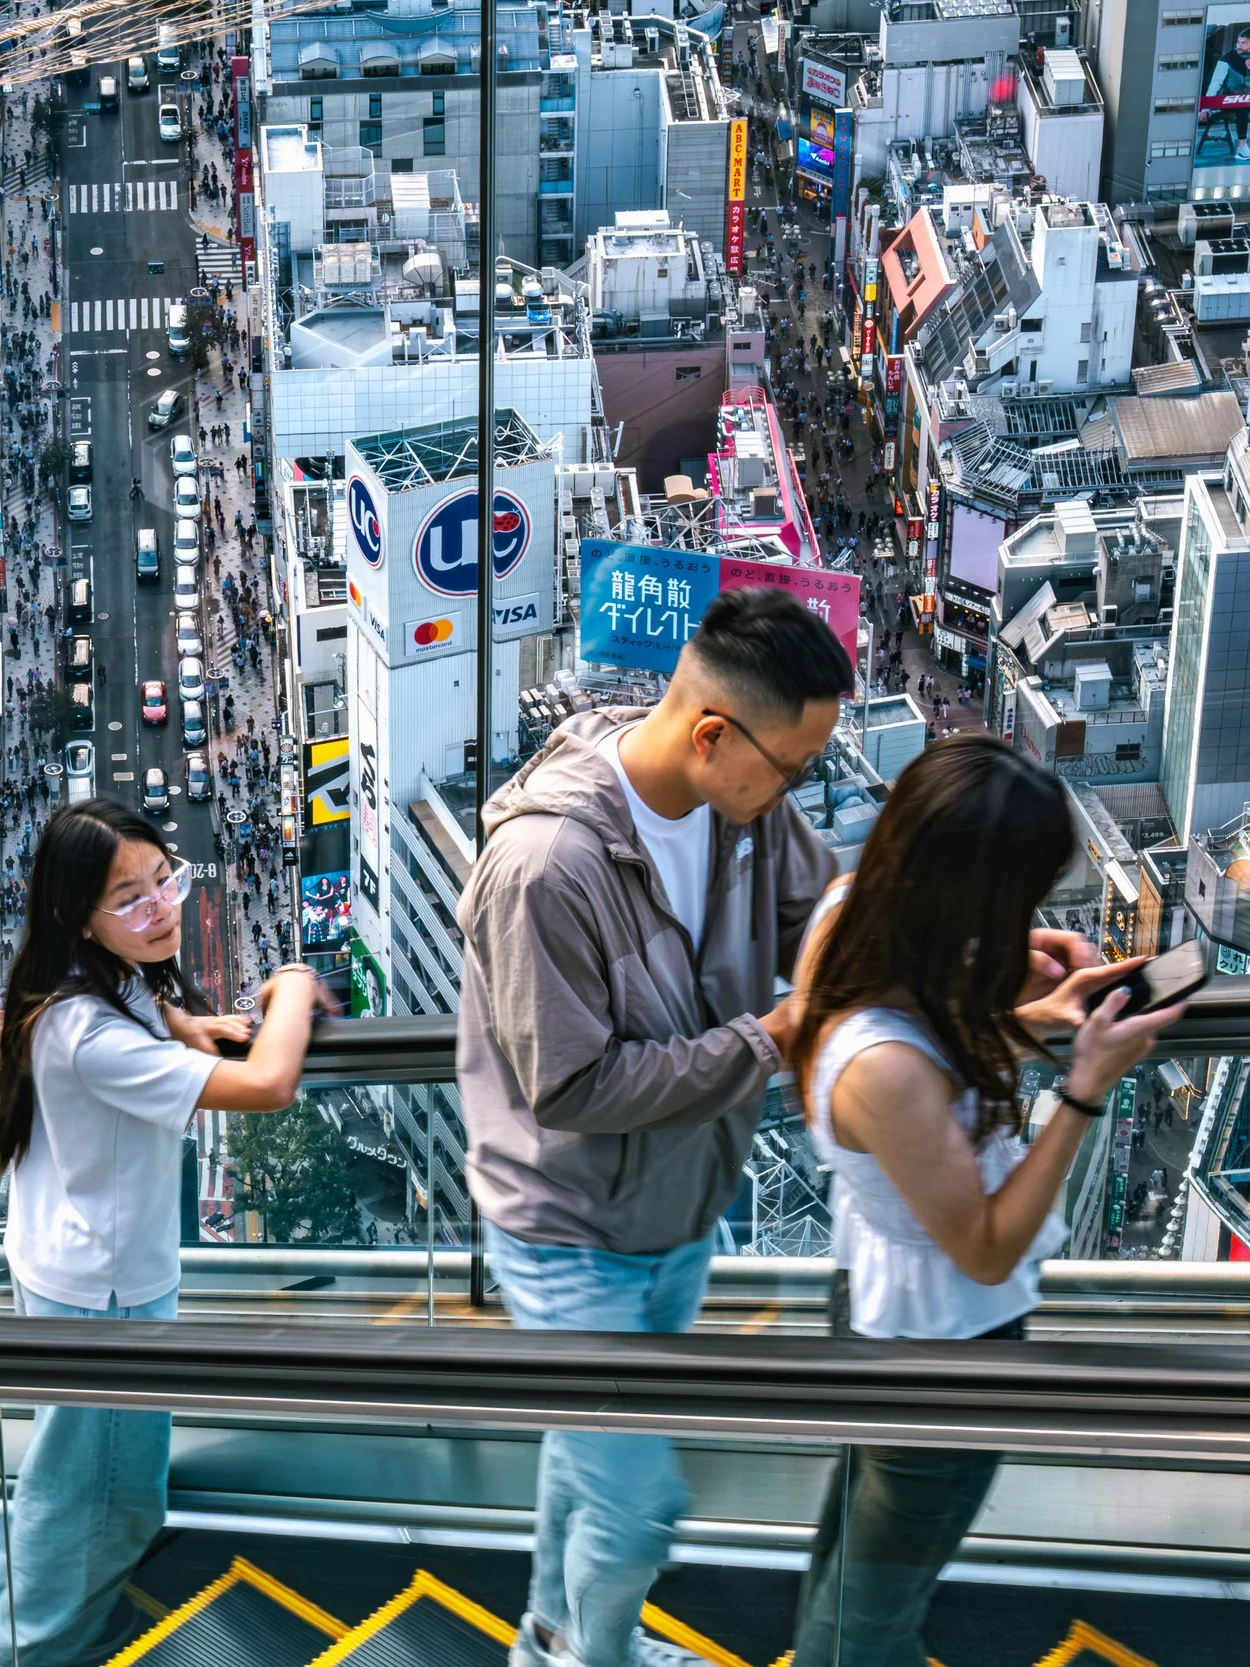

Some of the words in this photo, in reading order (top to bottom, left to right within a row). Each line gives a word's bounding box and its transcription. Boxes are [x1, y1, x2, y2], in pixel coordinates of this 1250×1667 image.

[611, 570, 691, 609] 龍角散
[492, 603, 537, 625] VISA
[599, 602, 702, 641] ダイレクト
[369, 615, 386, 641] VISA
[416, 640, 453, 653] mastercard
